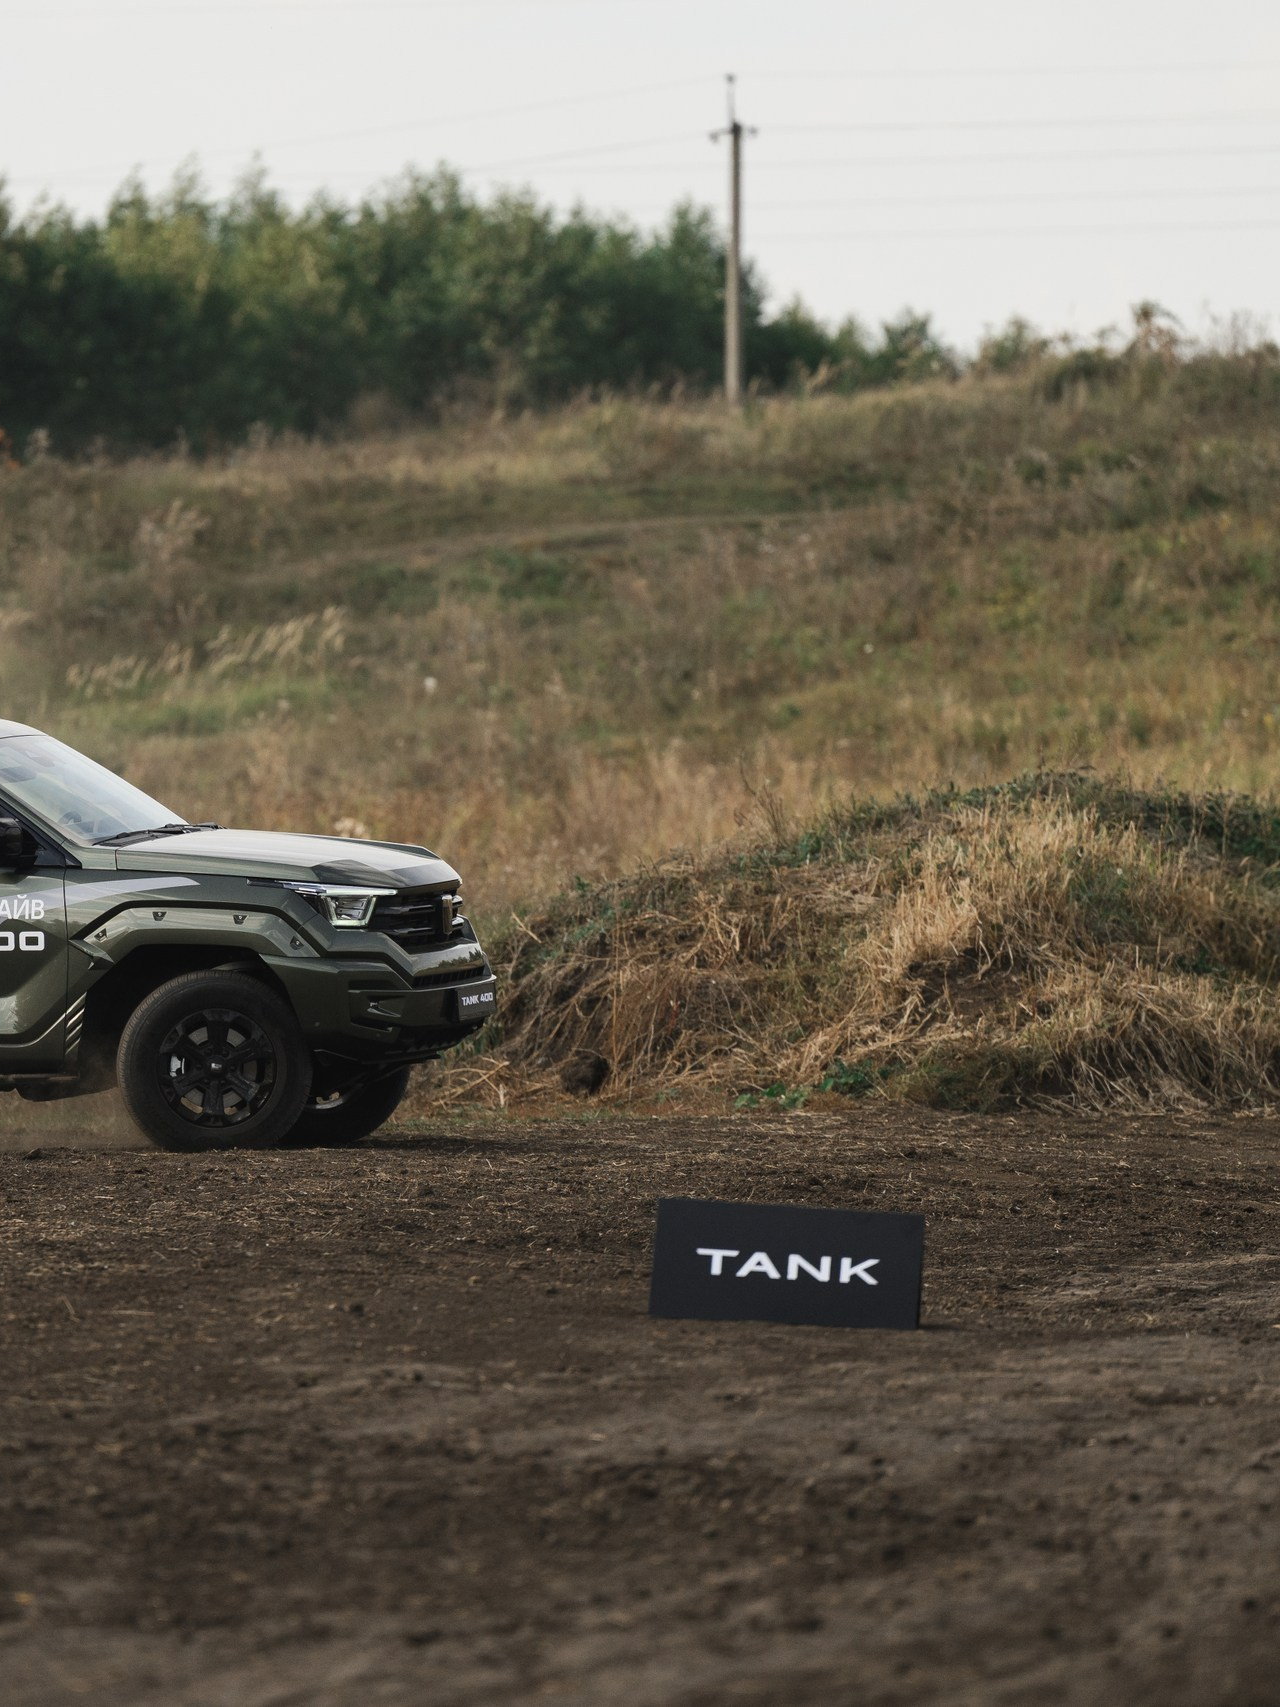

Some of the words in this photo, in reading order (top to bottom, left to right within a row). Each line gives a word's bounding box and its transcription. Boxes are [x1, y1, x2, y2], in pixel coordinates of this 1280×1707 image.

[461, 995, 479, 1006] TANK
[480, 992, 493, 1002] 400
[696, 1247, 880, 1285] TANK
